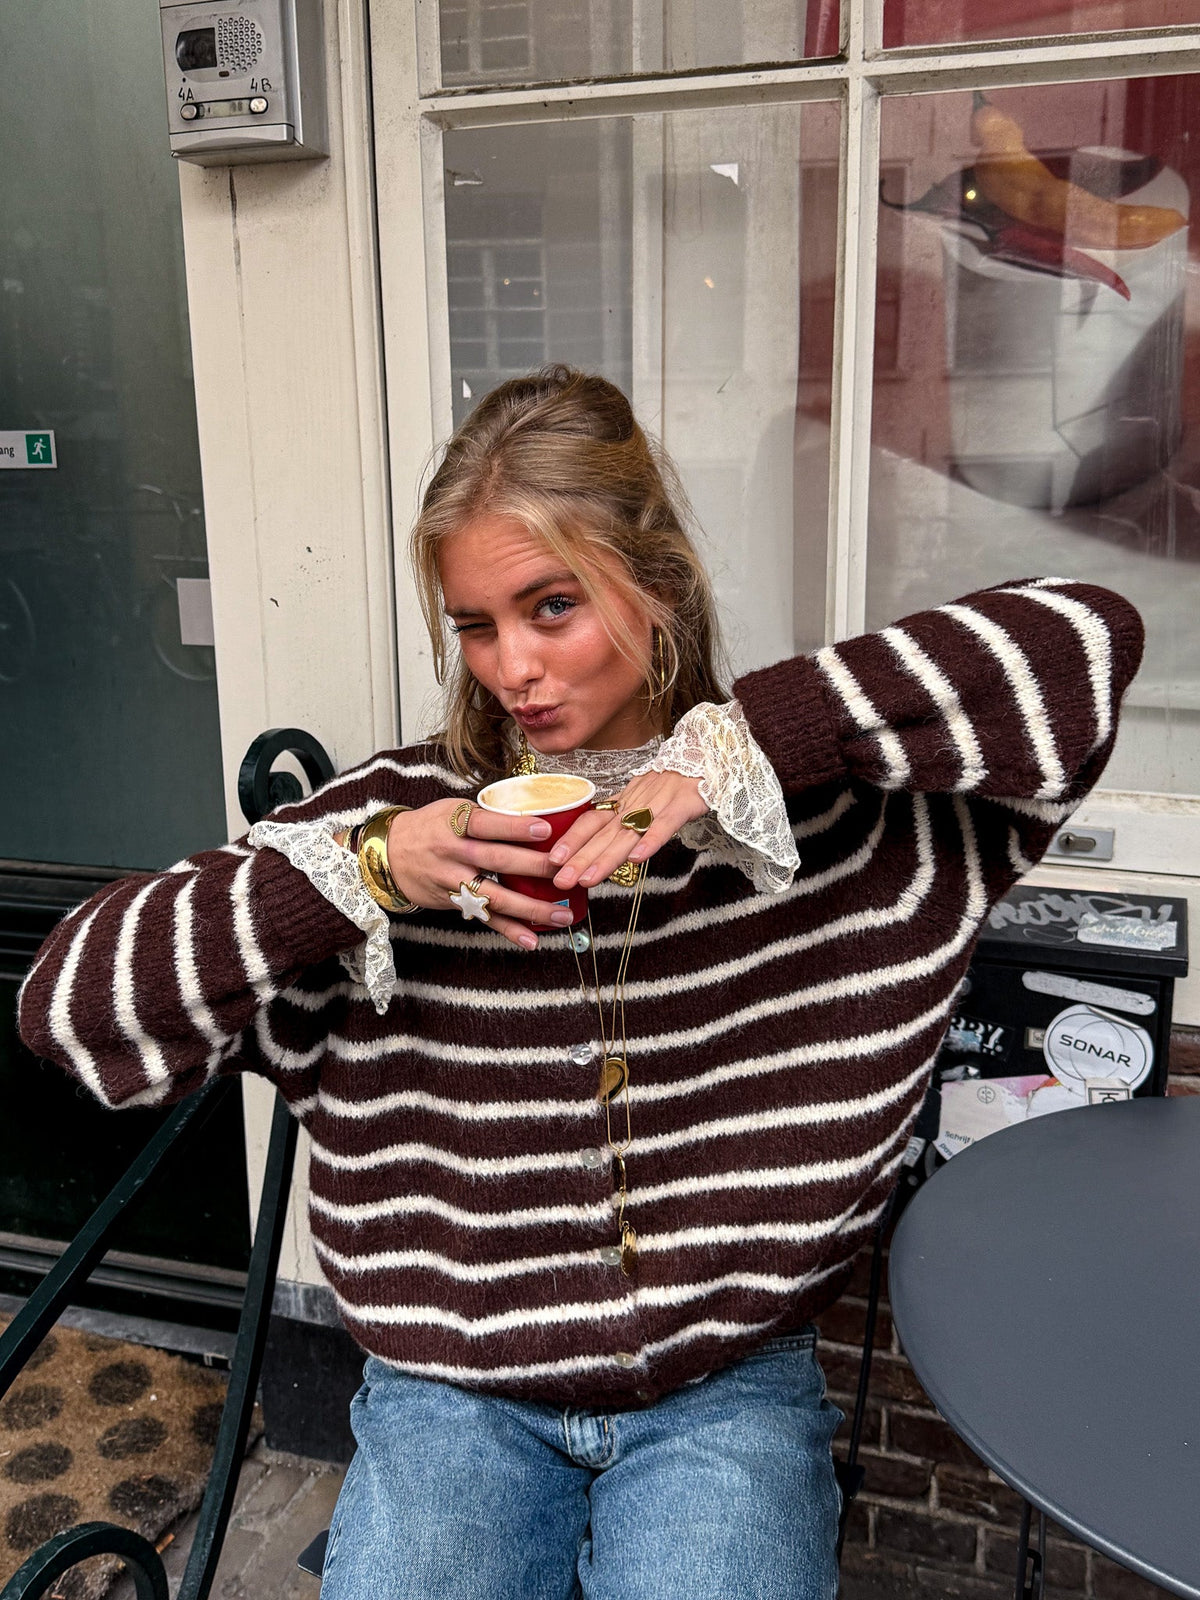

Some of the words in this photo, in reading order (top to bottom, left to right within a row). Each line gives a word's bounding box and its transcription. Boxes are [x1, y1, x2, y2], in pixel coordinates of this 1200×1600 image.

[250, 78, 272, 92] 4B
[178, 87, 194, 101] 4A
[1059, 1034, 1131, 1067] SONAR
